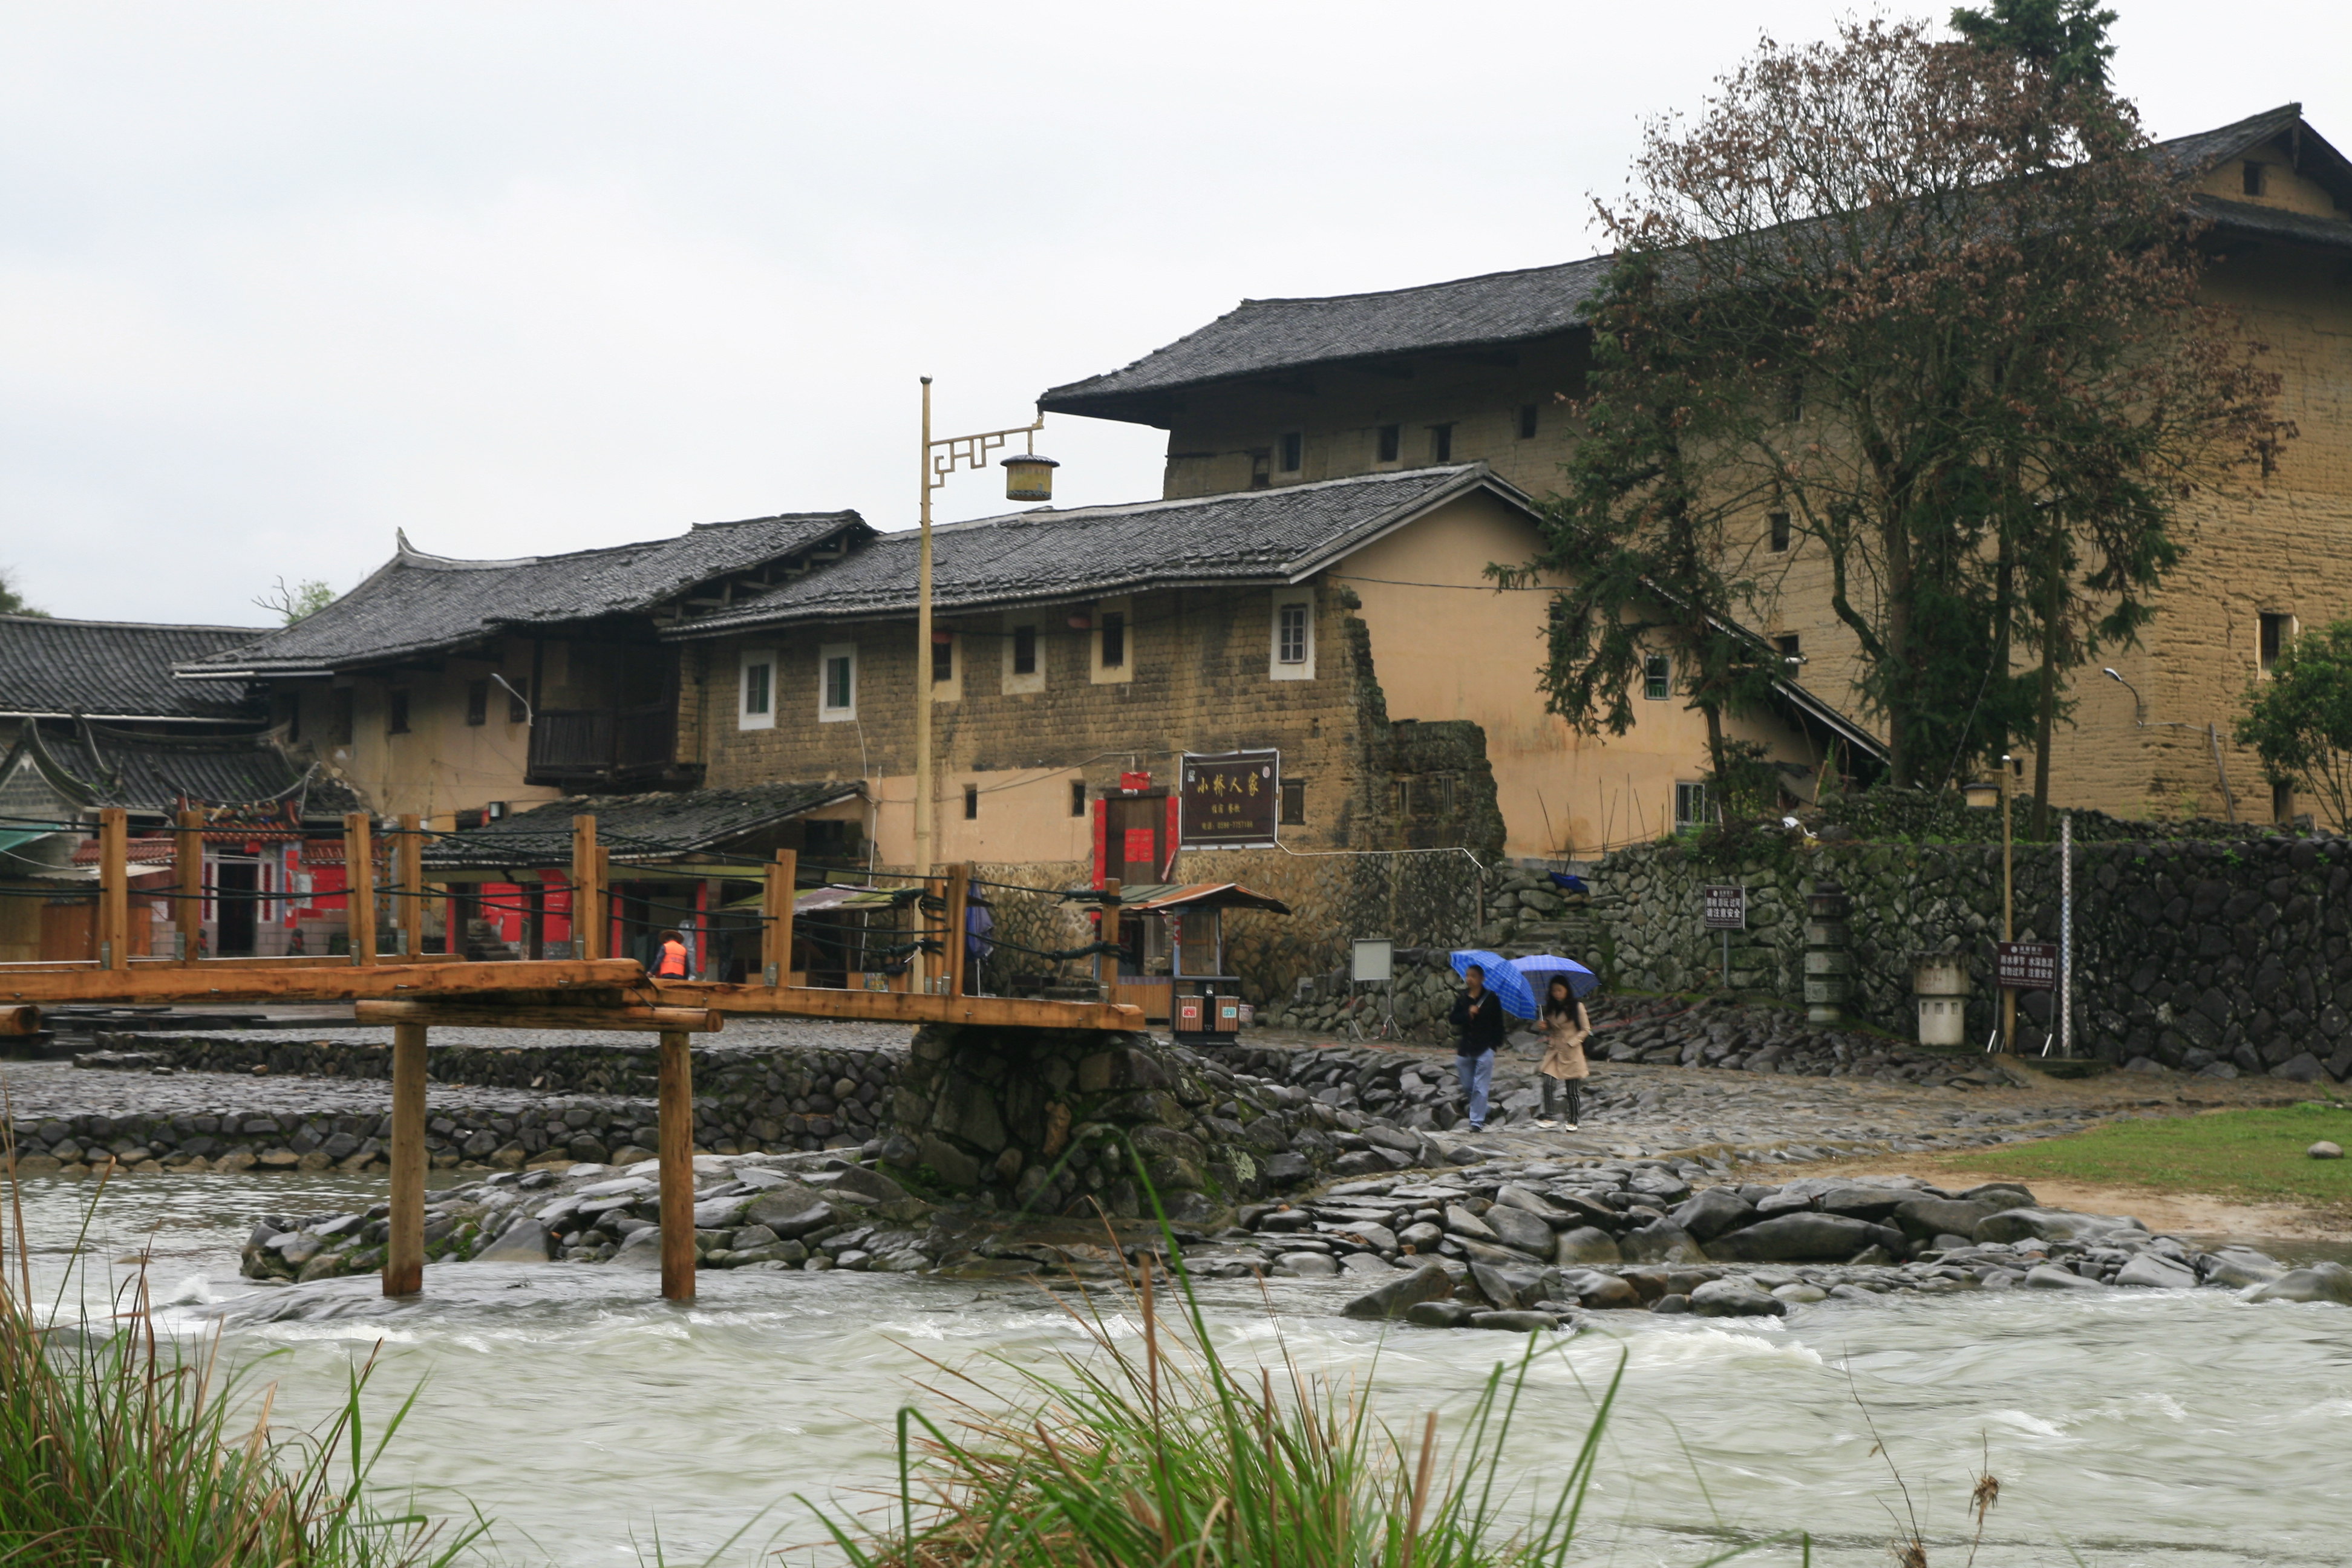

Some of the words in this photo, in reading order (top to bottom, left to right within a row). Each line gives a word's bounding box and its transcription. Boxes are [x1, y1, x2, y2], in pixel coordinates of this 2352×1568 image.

[1197, 771, 1259, 797] 小桥人家
[1707, 908, 1740, 918] 请注意安全
[2000, 966, 2025, 977] 请勿过河
[2028, 968, 2053, 979] 注意安全
